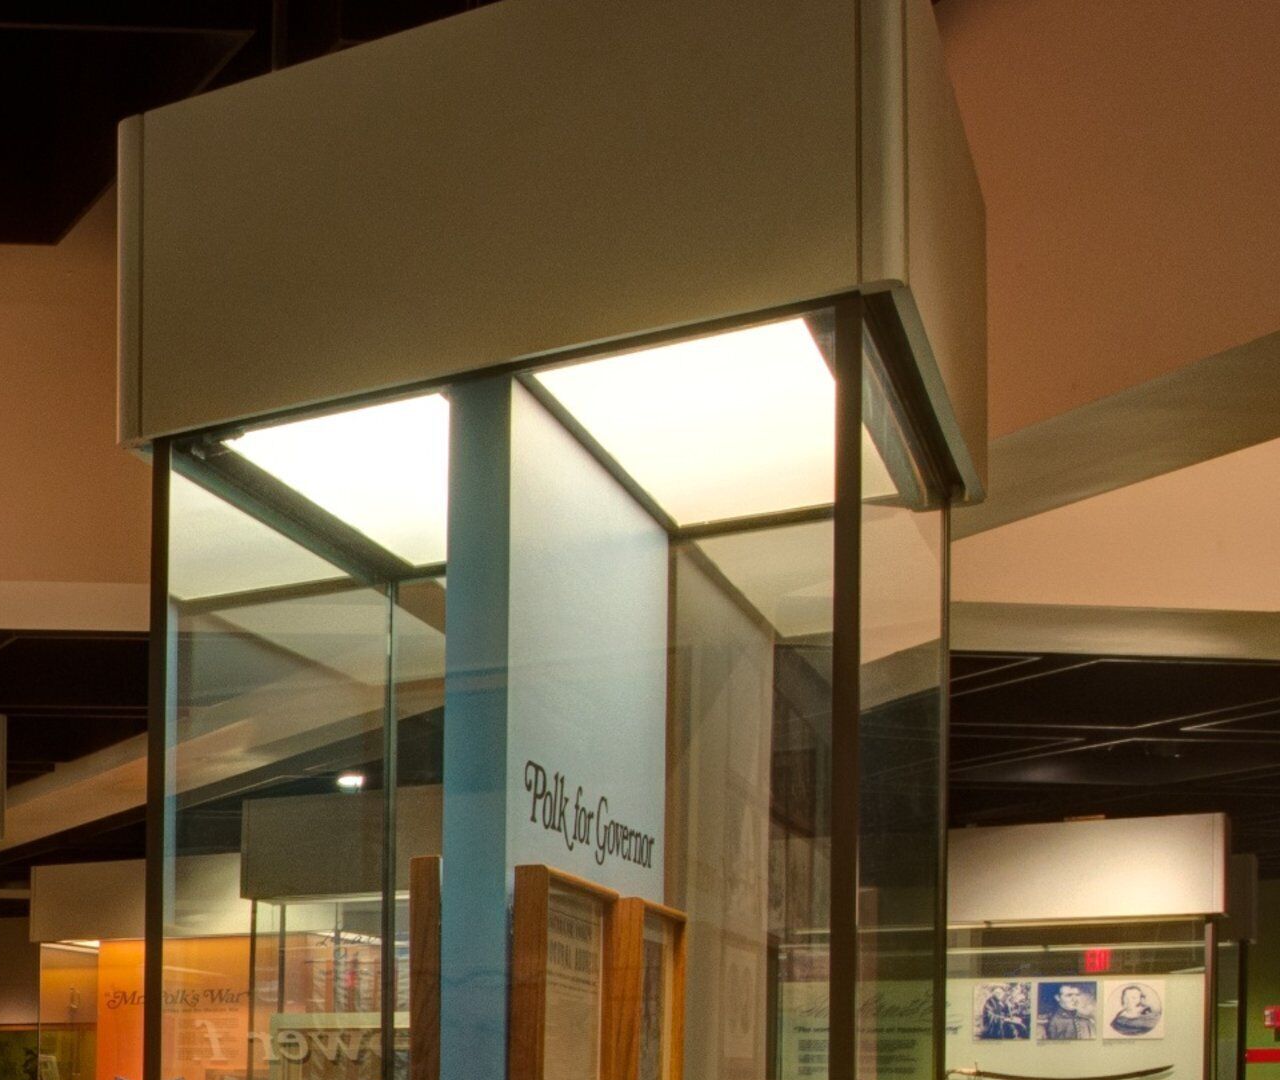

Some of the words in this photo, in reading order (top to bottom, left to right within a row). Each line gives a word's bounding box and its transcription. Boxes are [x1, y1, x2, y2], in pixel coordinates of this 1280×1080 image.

[524, 760, 574, 851] Polk
[572, 786, 594, 845] for
[595, 796, 655, 869] Governor
[161, 989, 200, 1008] olk's
